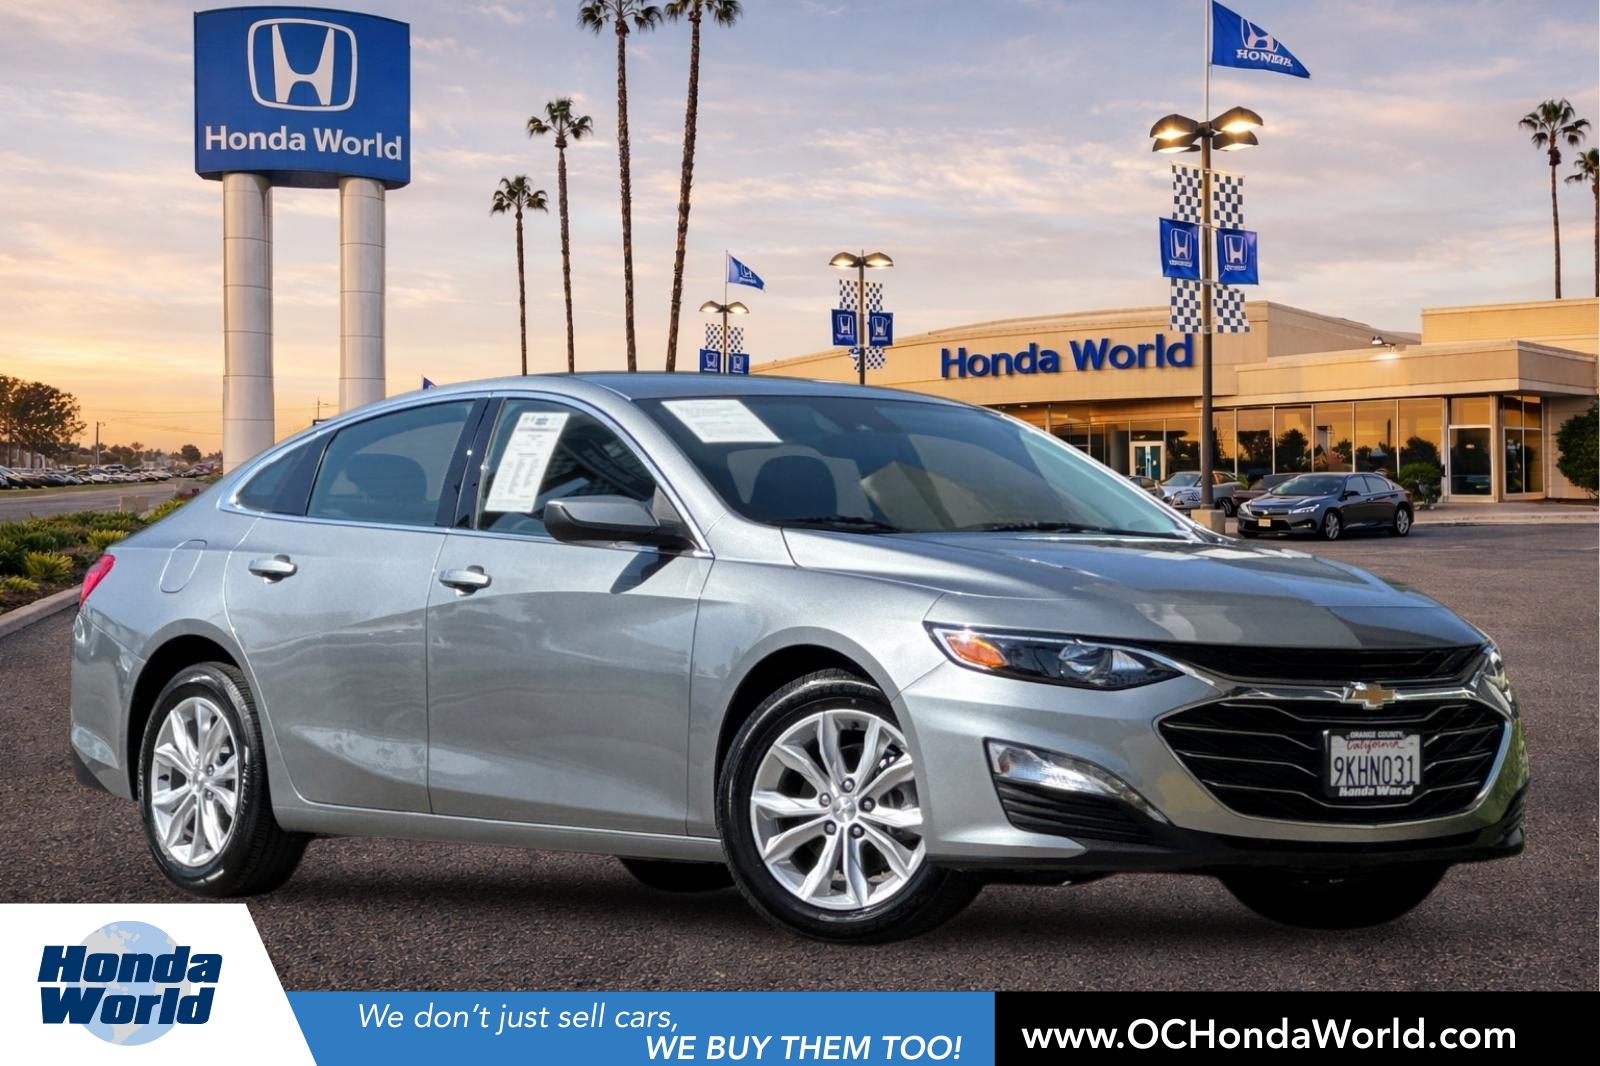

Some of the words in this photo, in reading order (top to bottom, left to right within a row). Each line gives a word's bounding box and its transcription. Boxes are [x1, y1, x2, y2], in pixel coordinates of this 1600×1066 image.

[205, 125, 306, 151] Honda
[313, 127, 402, 161] World
[940, 342, 1061, 378] Honda
[1069, 333, 1194, 371] World
[1346, 740, 1404, 754] California
[1334, 755, 1416, 786] 9KHN031
[1339, 787, 1375, 797] Honda
